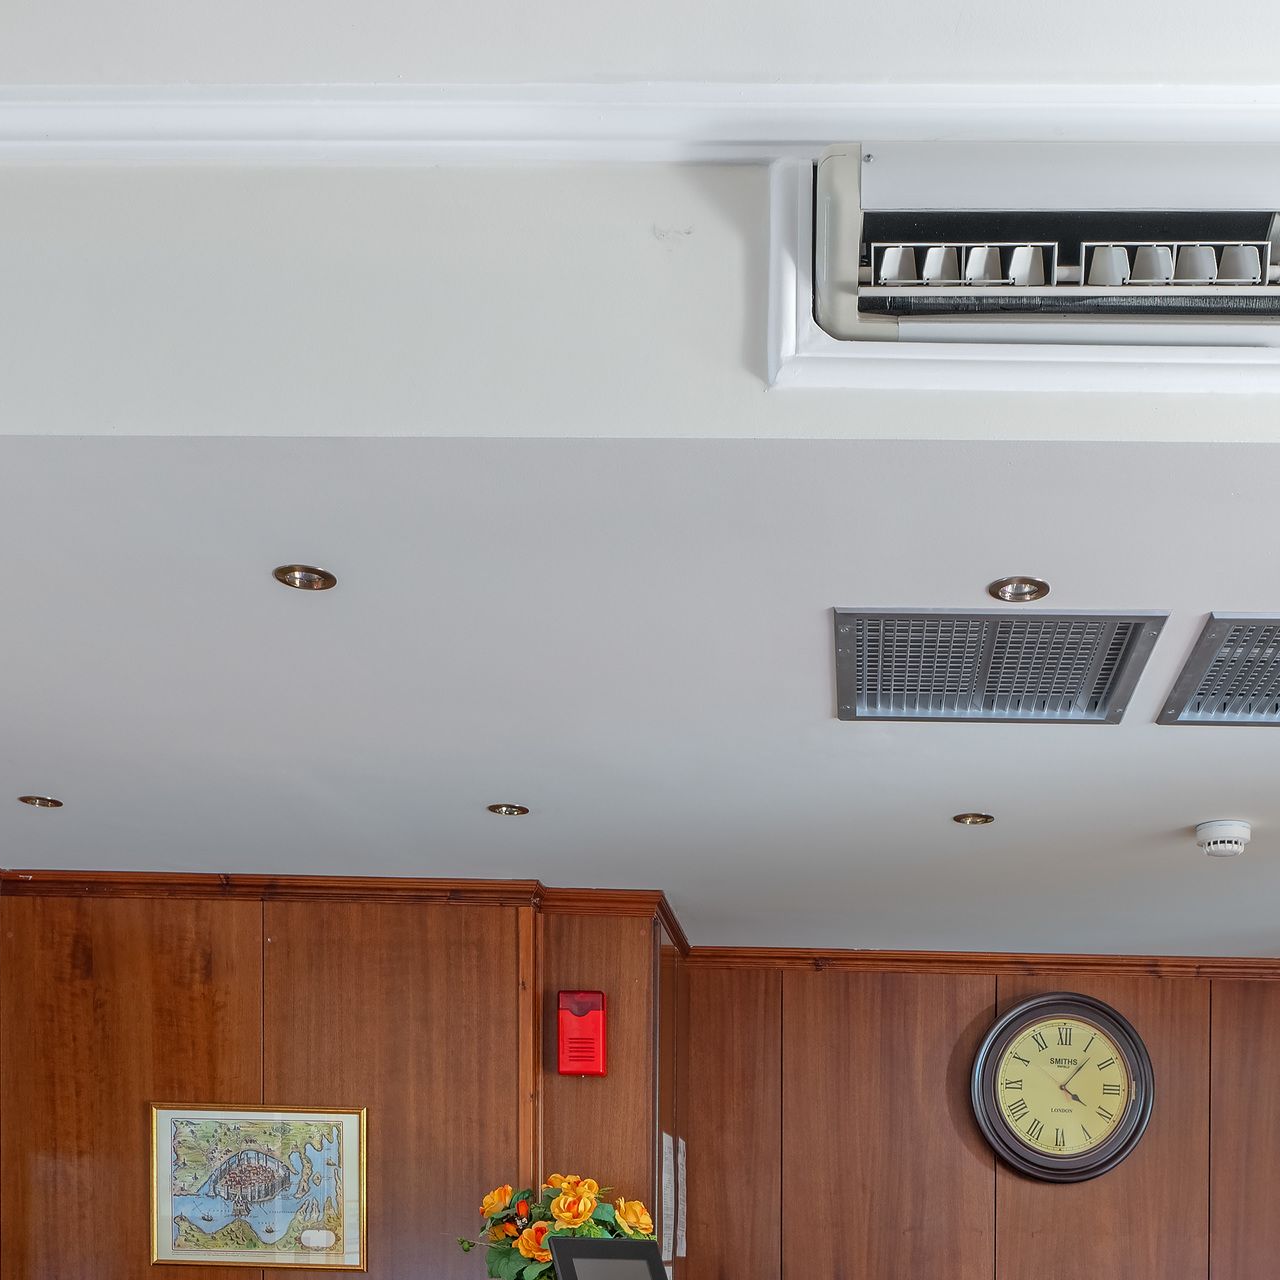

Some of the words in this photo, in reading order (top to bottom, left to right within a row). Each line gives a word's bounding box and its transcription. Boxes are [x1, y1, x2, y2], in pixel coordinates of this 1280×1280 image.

[1031, 1031, 1048, 1052] XI
[1056, 1027, 1072, 1046] XII
[1012, 1052, 1030, 1067] X
[1049, 1057, 1079, 1066] SMITHS
[1097, 1057, 1115, 1071] II
[1005, 1078, 1023, 1090] IX
[1103, 1084, 1120, 1096] III
[1008, 1098, 1030, 1122] VIII
[1026, 1118, 1045, 1141] VII
[1055, 1128, 1066, 1147] VI
[1080, 1123, 1092, 1141] V
